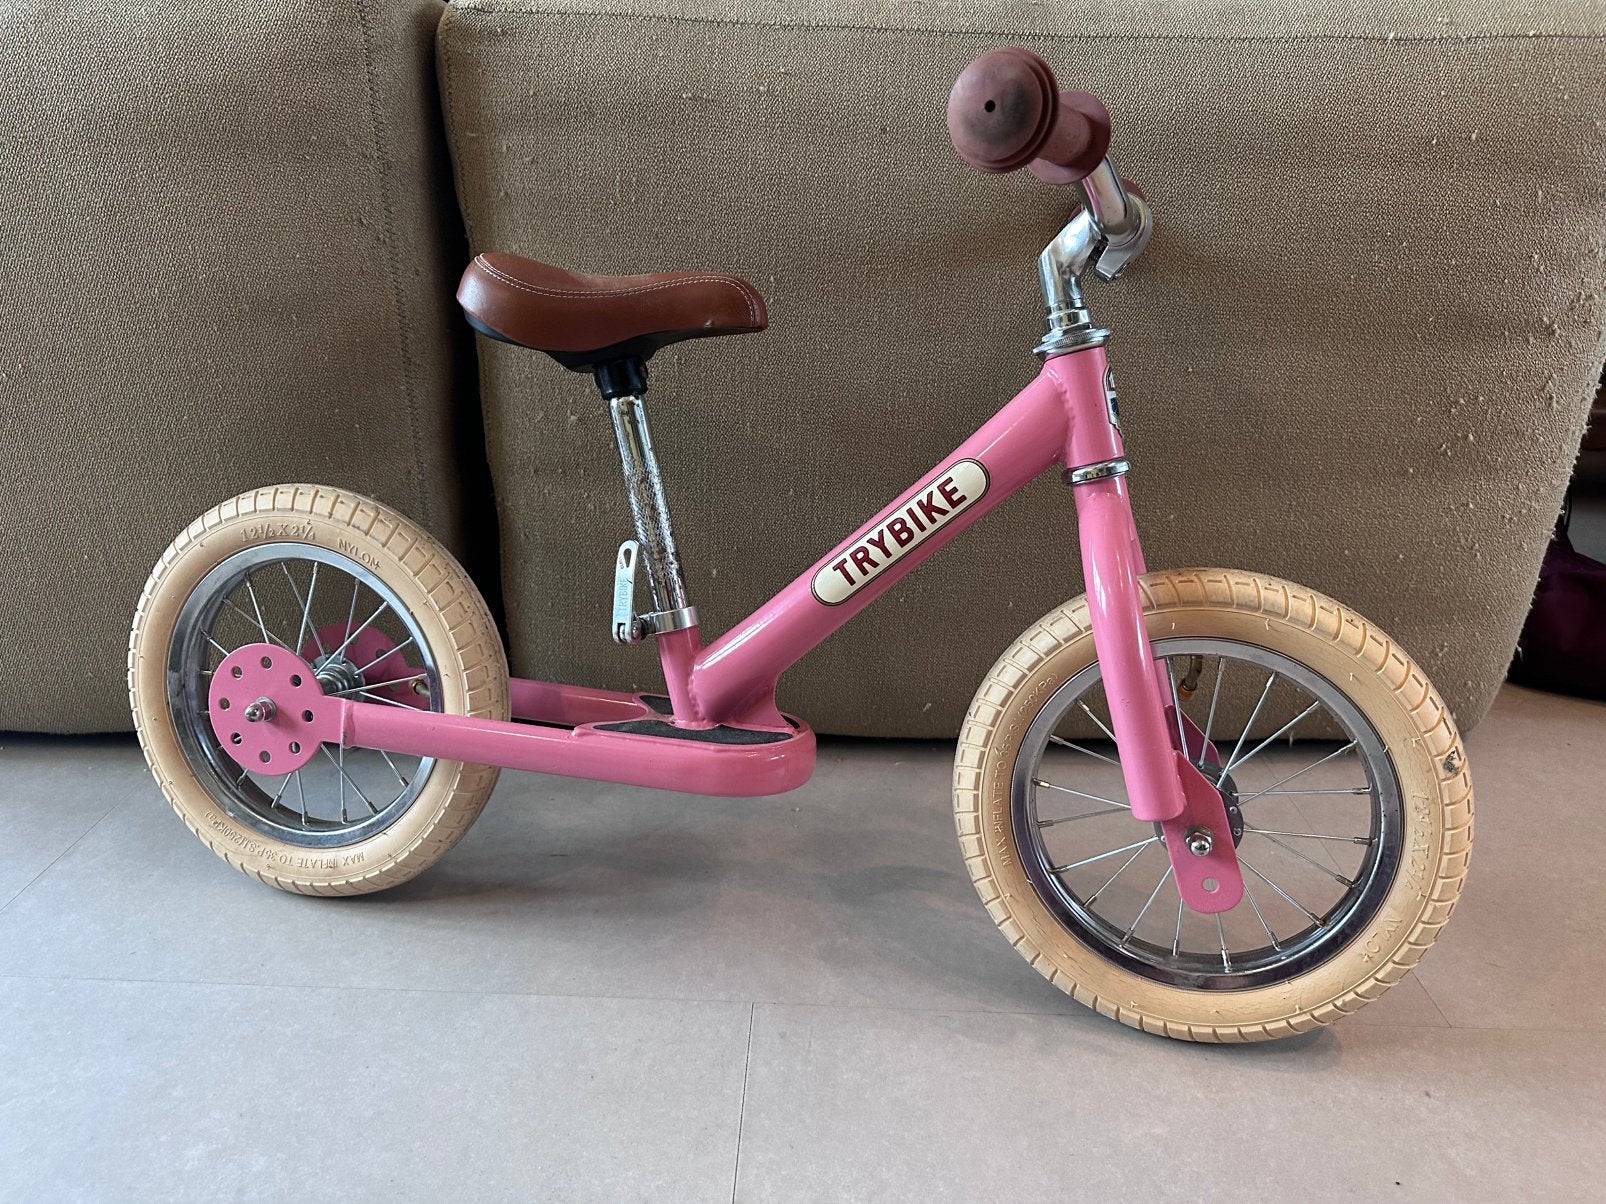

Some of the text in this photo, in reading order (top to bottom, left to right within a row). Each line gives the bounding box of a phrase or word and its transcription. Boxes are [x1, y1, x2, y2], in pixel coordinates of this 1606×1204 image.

[832, 476, 968, 587] TRYBIKE
[337, 538, 381, 571] NYLON
[618, 576, 629, 613] TRYBIKE
[279, 854, 294, 868] TO
[297, 858, 338, 869] INFLATE
[343, 851, 365, 867] MAX
[995, 836, 1013, 867] MAX
